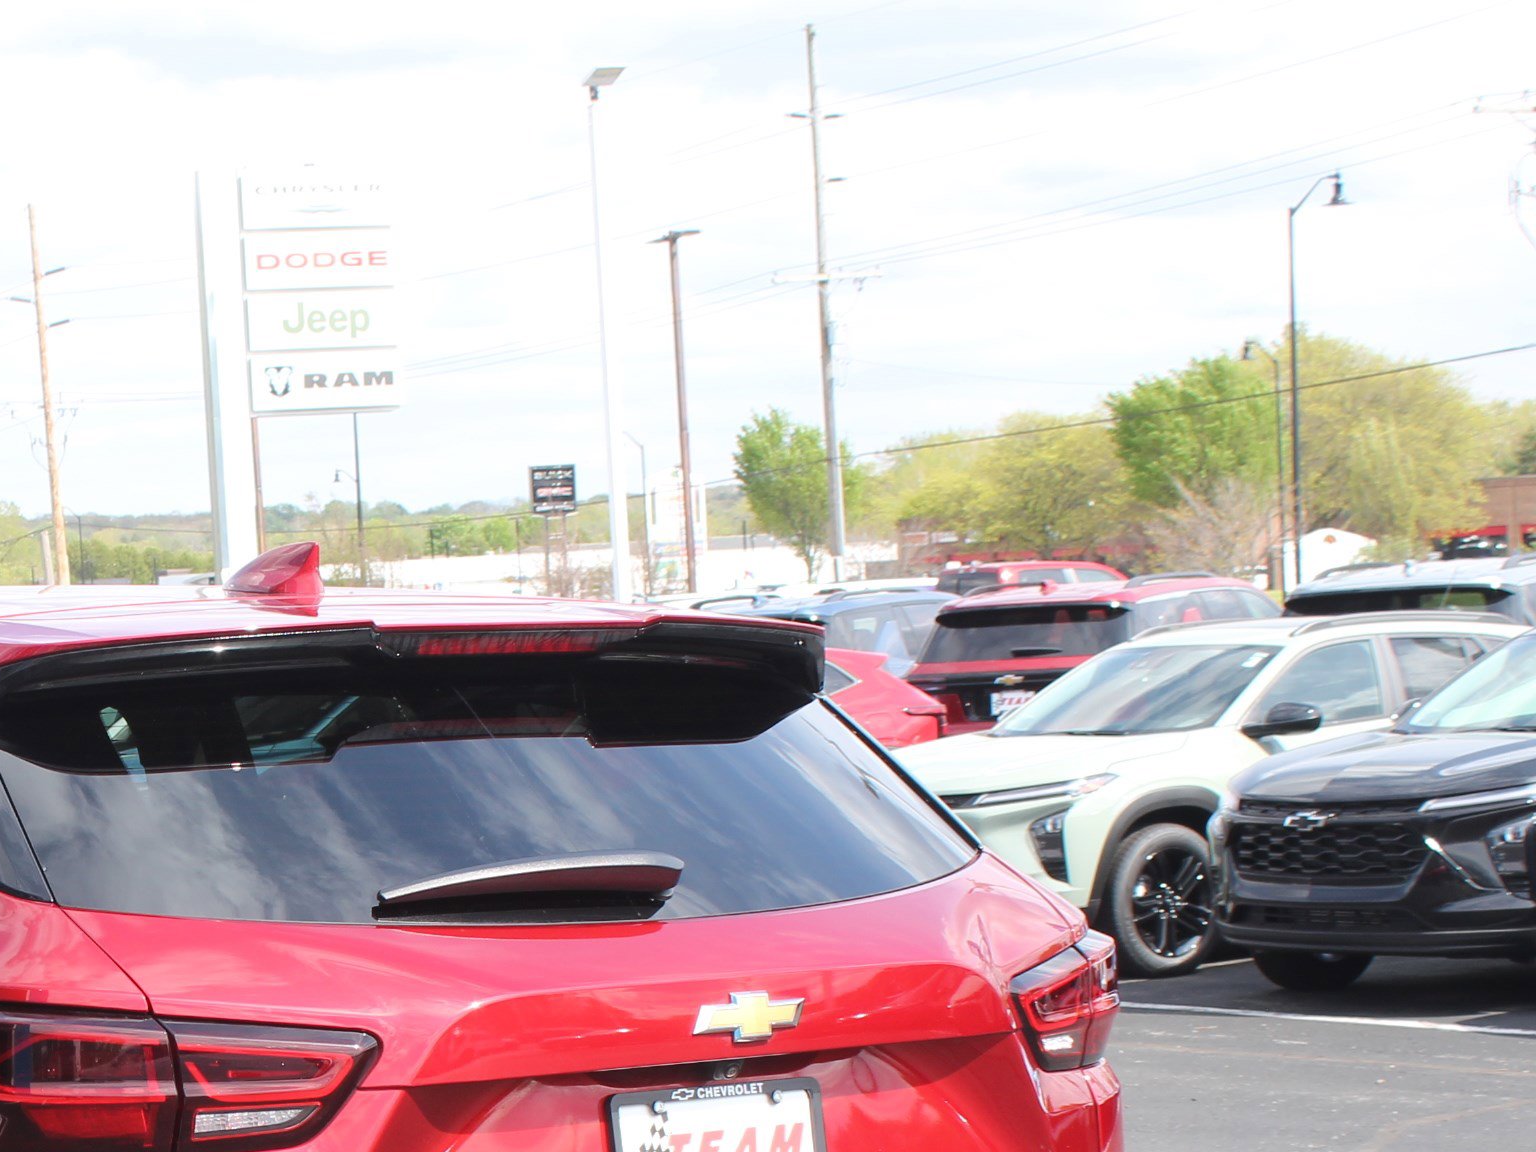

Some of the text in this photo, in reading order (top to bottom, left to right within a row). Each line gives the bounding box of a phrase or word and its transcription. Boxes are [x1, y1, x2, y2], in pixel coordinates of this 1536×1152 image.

[256, 250, 388, 270] DODGE
[282, 302, 370, 338] Jeep
[303, 370, 394, 389] RAM
[697, 1083, 764, 1099] CHEVROLET
